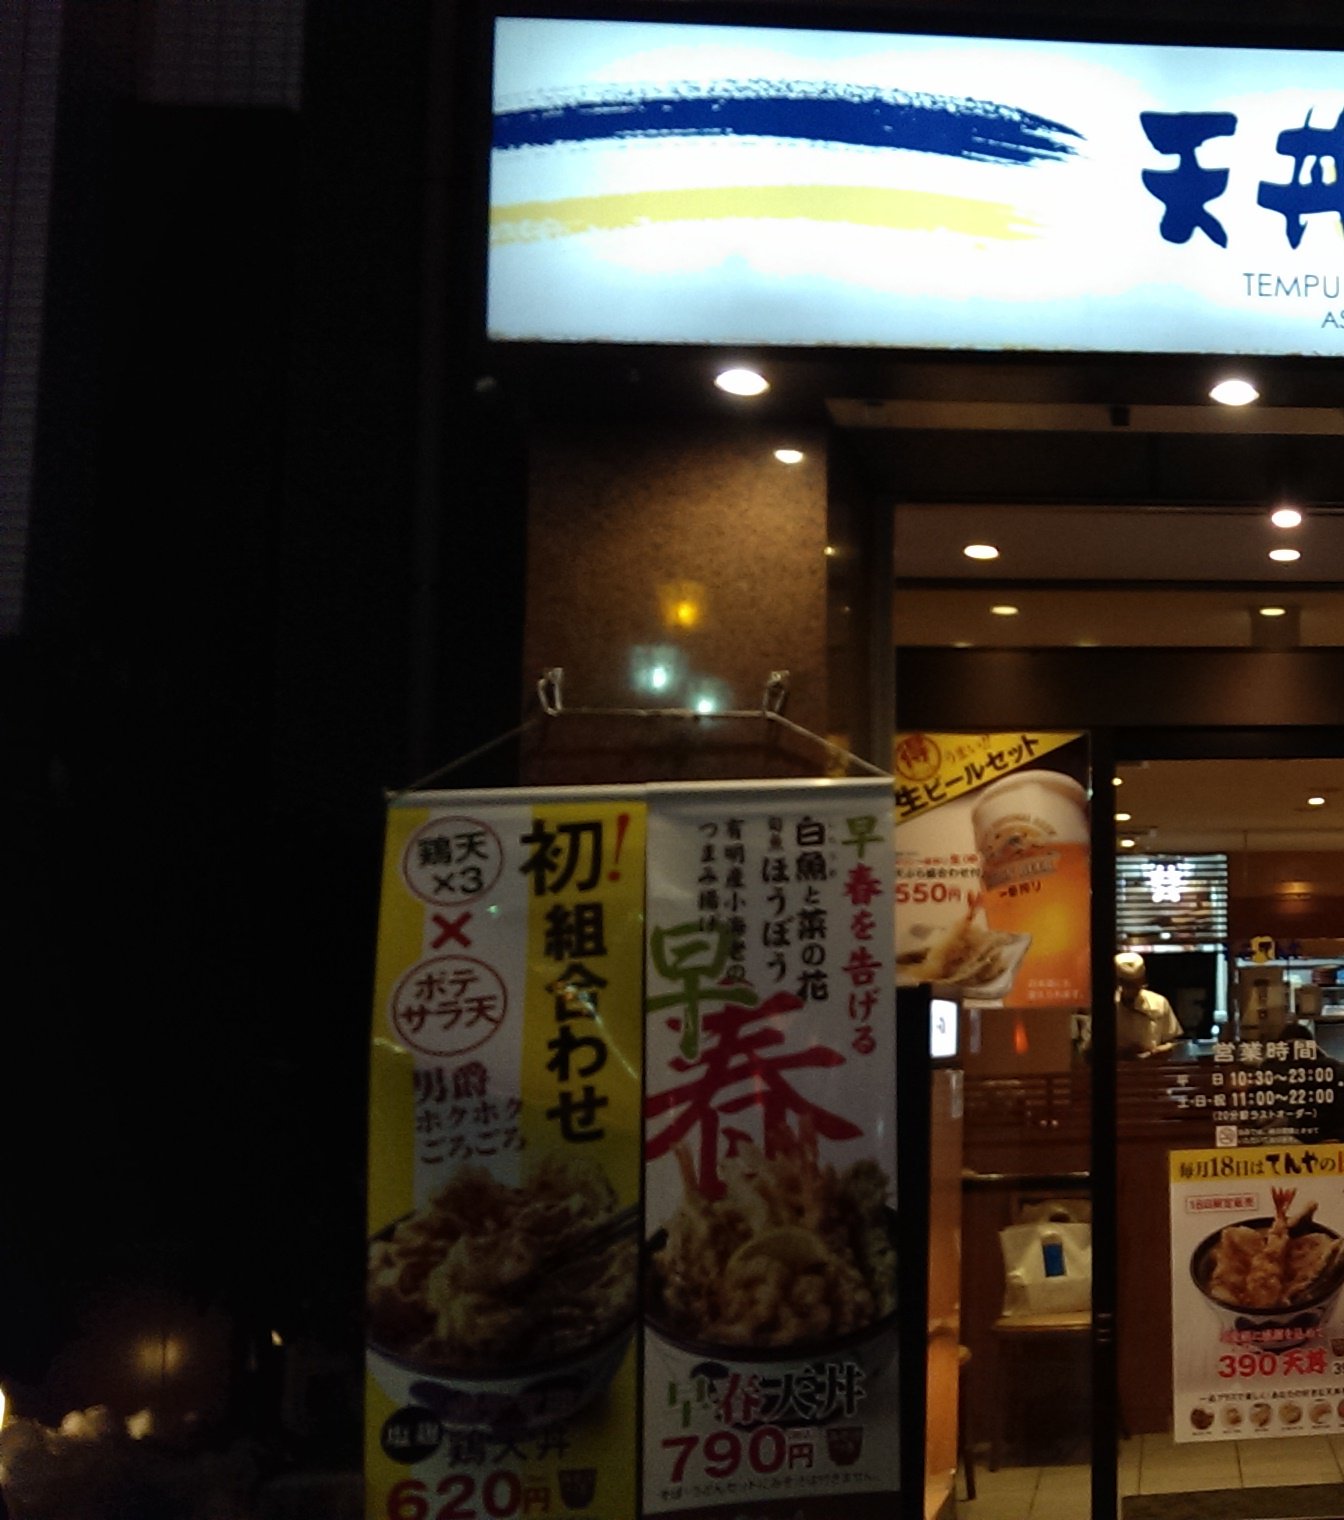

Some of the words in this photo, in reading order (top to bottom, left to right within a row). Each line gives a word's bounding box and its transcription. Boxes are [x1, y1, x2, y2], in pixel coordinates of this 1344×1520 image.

[895, 734, 1039, 817] 生ビールセット
[841, 815, 884, 1055] 早春を告げる
[1212, 1040, 1318, 1063] 営業時間
[661, 1424, 814, 1483] 790円
[387, 1470, 551, 1520] 620円
